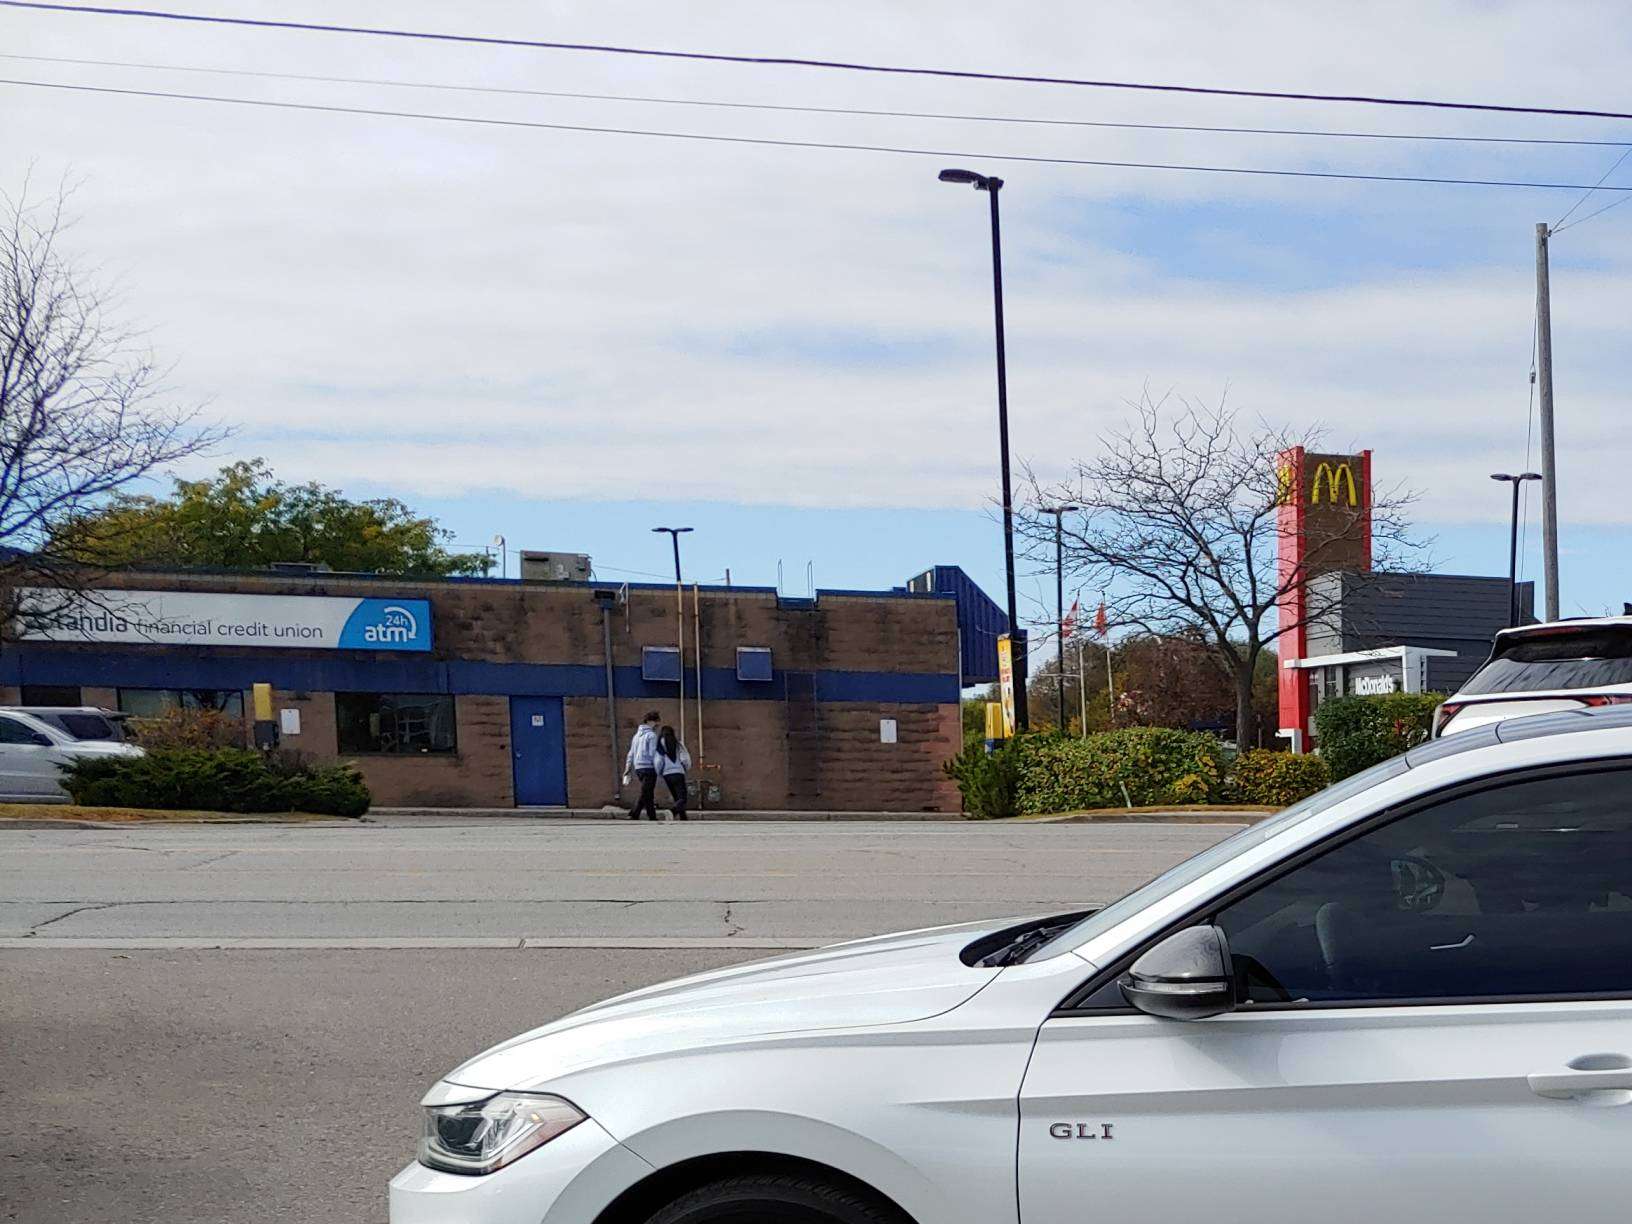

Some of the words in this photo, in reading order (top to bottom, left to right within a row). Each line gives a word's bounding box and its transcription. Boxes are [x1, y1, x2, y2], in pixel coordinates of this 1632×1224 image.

[138, 619, 211, 636] financial
[217, 621, 268, 637] credit
[274, 622, 324, 639] union
[385, 614, 408, 626] 24h
[364, 623, 408, 642] atm
[1355, 675, 1393, 695] McDonald's
[1049, 1122, 1114, 1140] GLI
